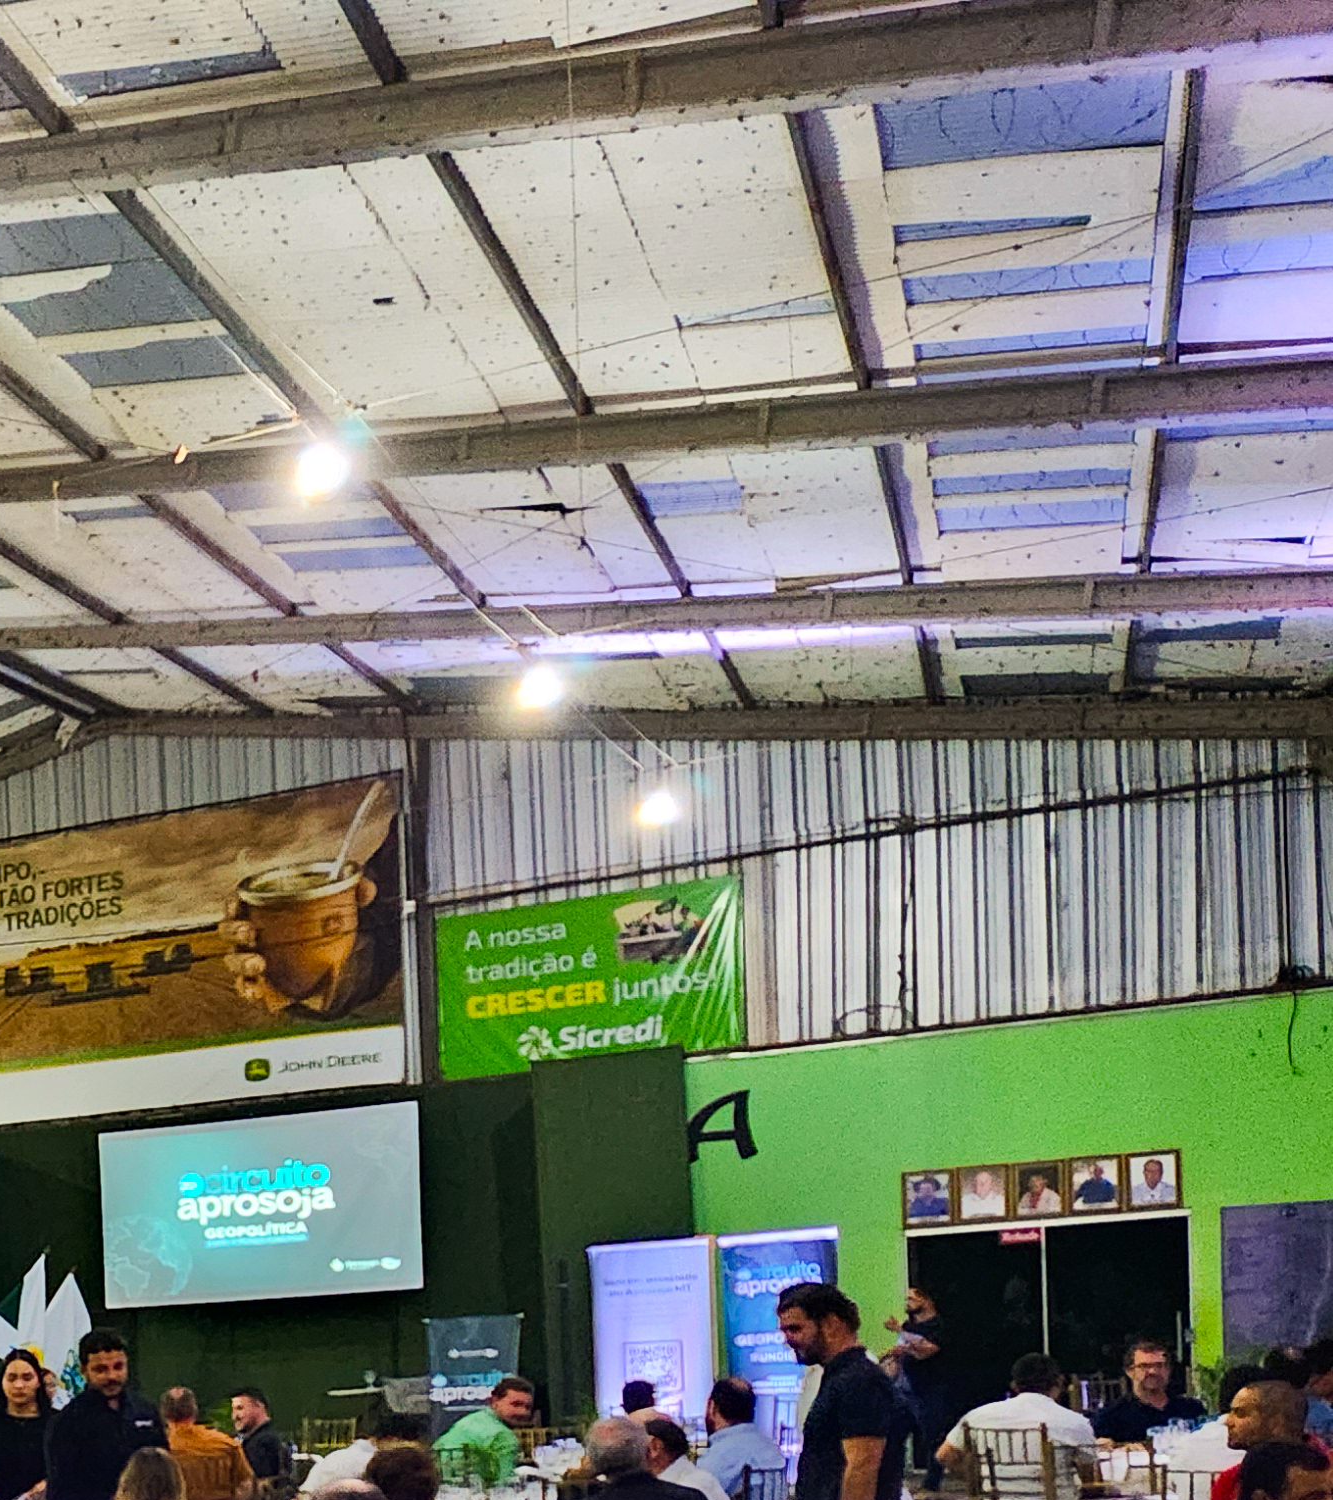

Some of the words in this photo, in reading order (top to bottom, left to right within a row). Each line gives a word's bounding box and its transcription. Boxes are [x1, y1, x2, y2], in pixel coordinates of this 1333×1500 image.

[43, 870, 124, 900] FORTES
[3, 896, 122, 931] TRADIÇÕES
[465, 930, 482, 950] A
[489, 923, 566, 948] nossa
[466, 952, 573, 984] tradição
[582, 945, 597, 969] é
[466, 980, 606, 1018] CRESCER
[558, 1015, 662, 1050] Sicredi
[277, 1058, 323, 1074] JOHN
[205, 1158, 330, 1194] circuito
[177, 1186, 336, 1226] aprosoja
[204, 1221, 308, 1239] GEOPOLÍTICA
